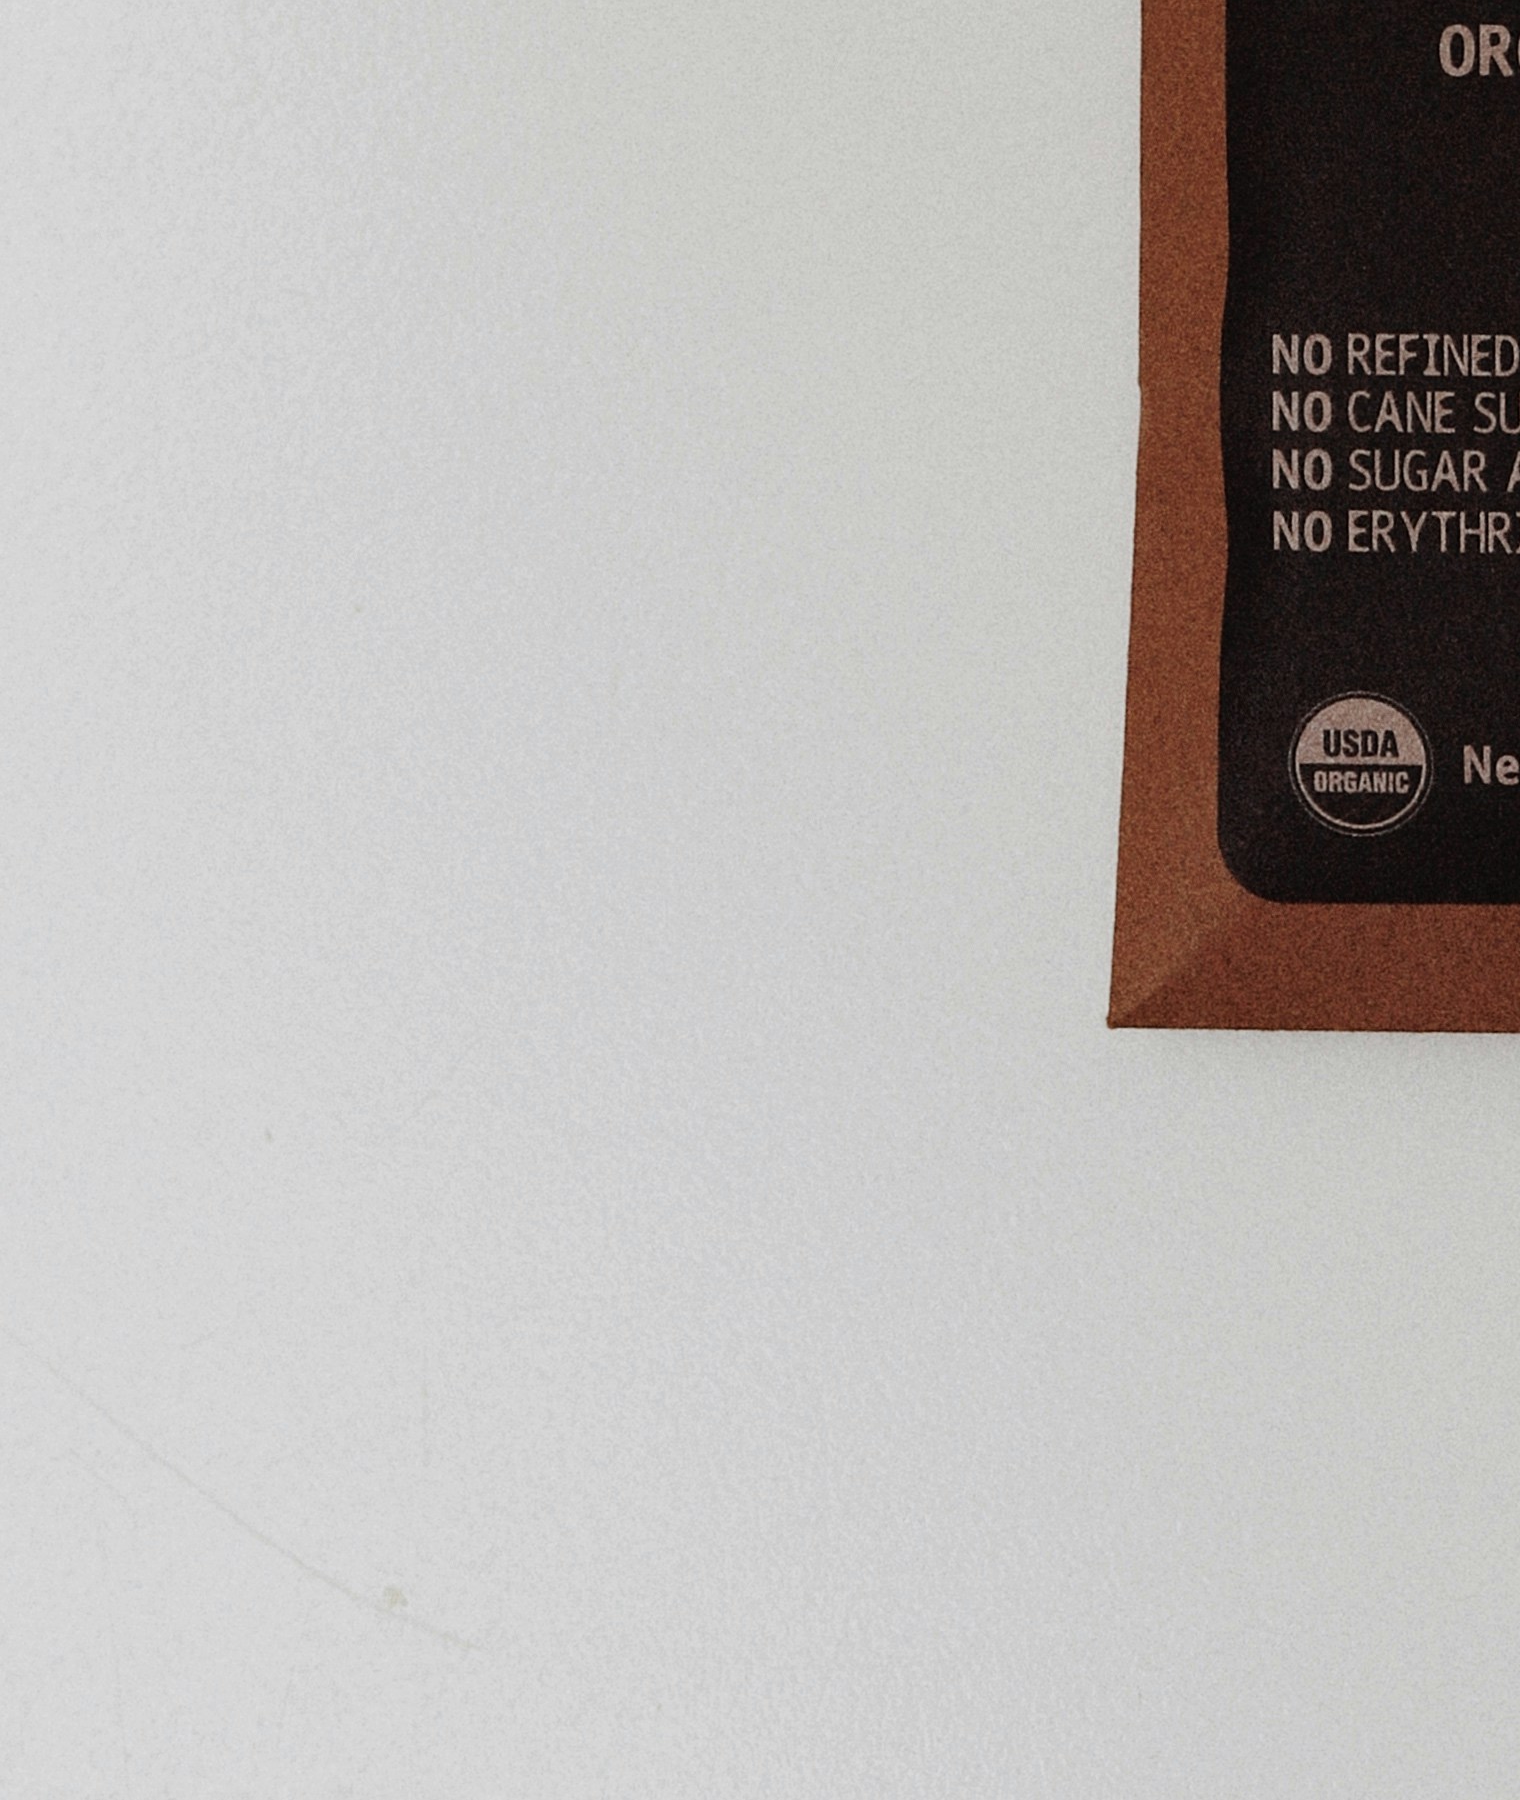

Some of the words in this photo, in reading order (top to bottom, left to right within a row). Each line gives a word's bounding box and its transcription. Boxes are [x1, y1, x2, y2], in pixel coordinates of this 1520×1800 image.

[1272, 333, 1333, 376] NO
[1347, 332, 1520, 377] REFINED
[1272, 390, 1333, 433] NO
[1347, 390, 1455, 434] CANE
[1272, 448, 1333, 491] NO
[1349, 448, 1488, 492] SUGAR
[1273, 510, 1333, 553] NO
[1322, 728, 1400, 758] USDA
[1313, 770, 1410, 794] ORGANIC
